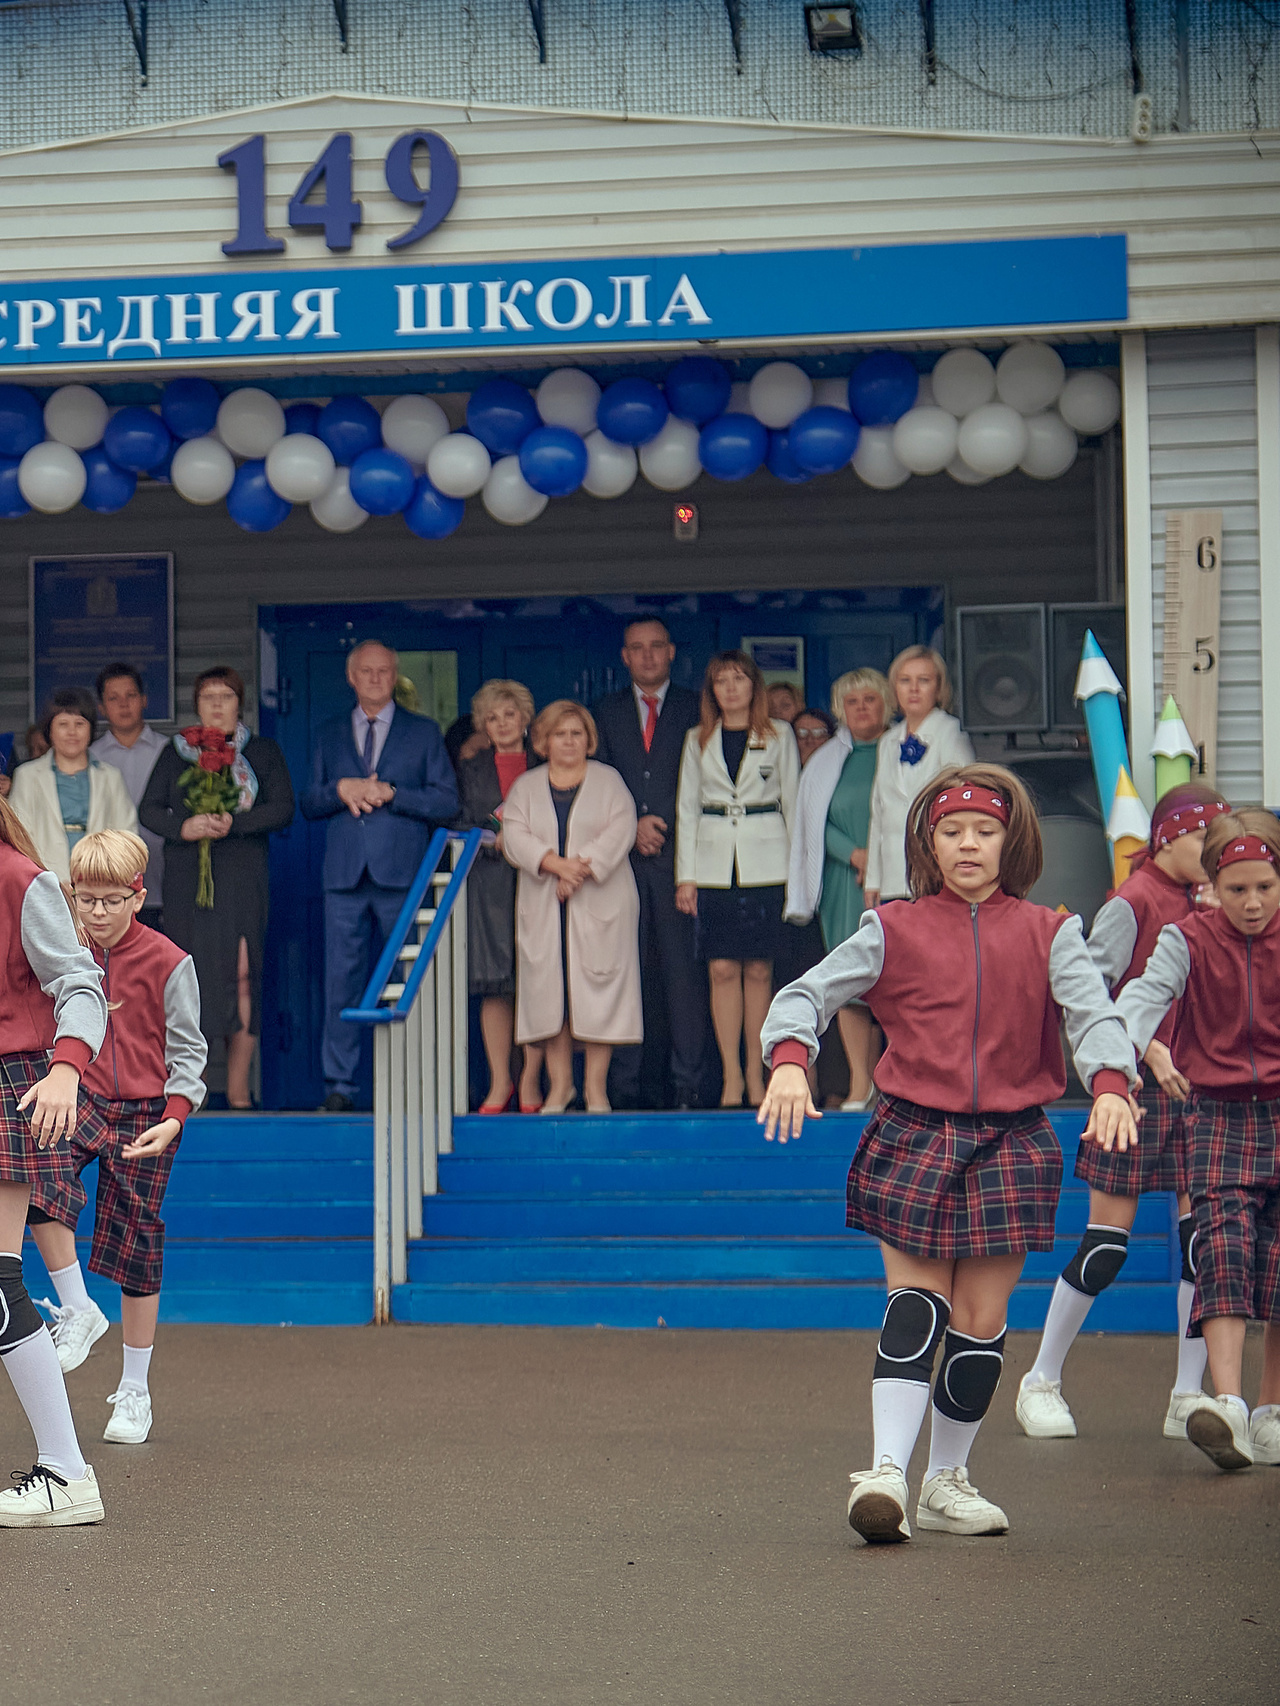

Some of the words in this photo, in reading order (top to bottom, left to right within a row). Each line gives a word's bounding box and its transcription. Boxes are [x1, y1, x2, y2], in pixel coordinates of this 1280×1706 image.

[217, 127, 461, 256] 149
[395, 273, 713, 337] ШКОЛА
[1197, 536, 1216, 572] 6
[1193, 636, 1215, 674] 5
